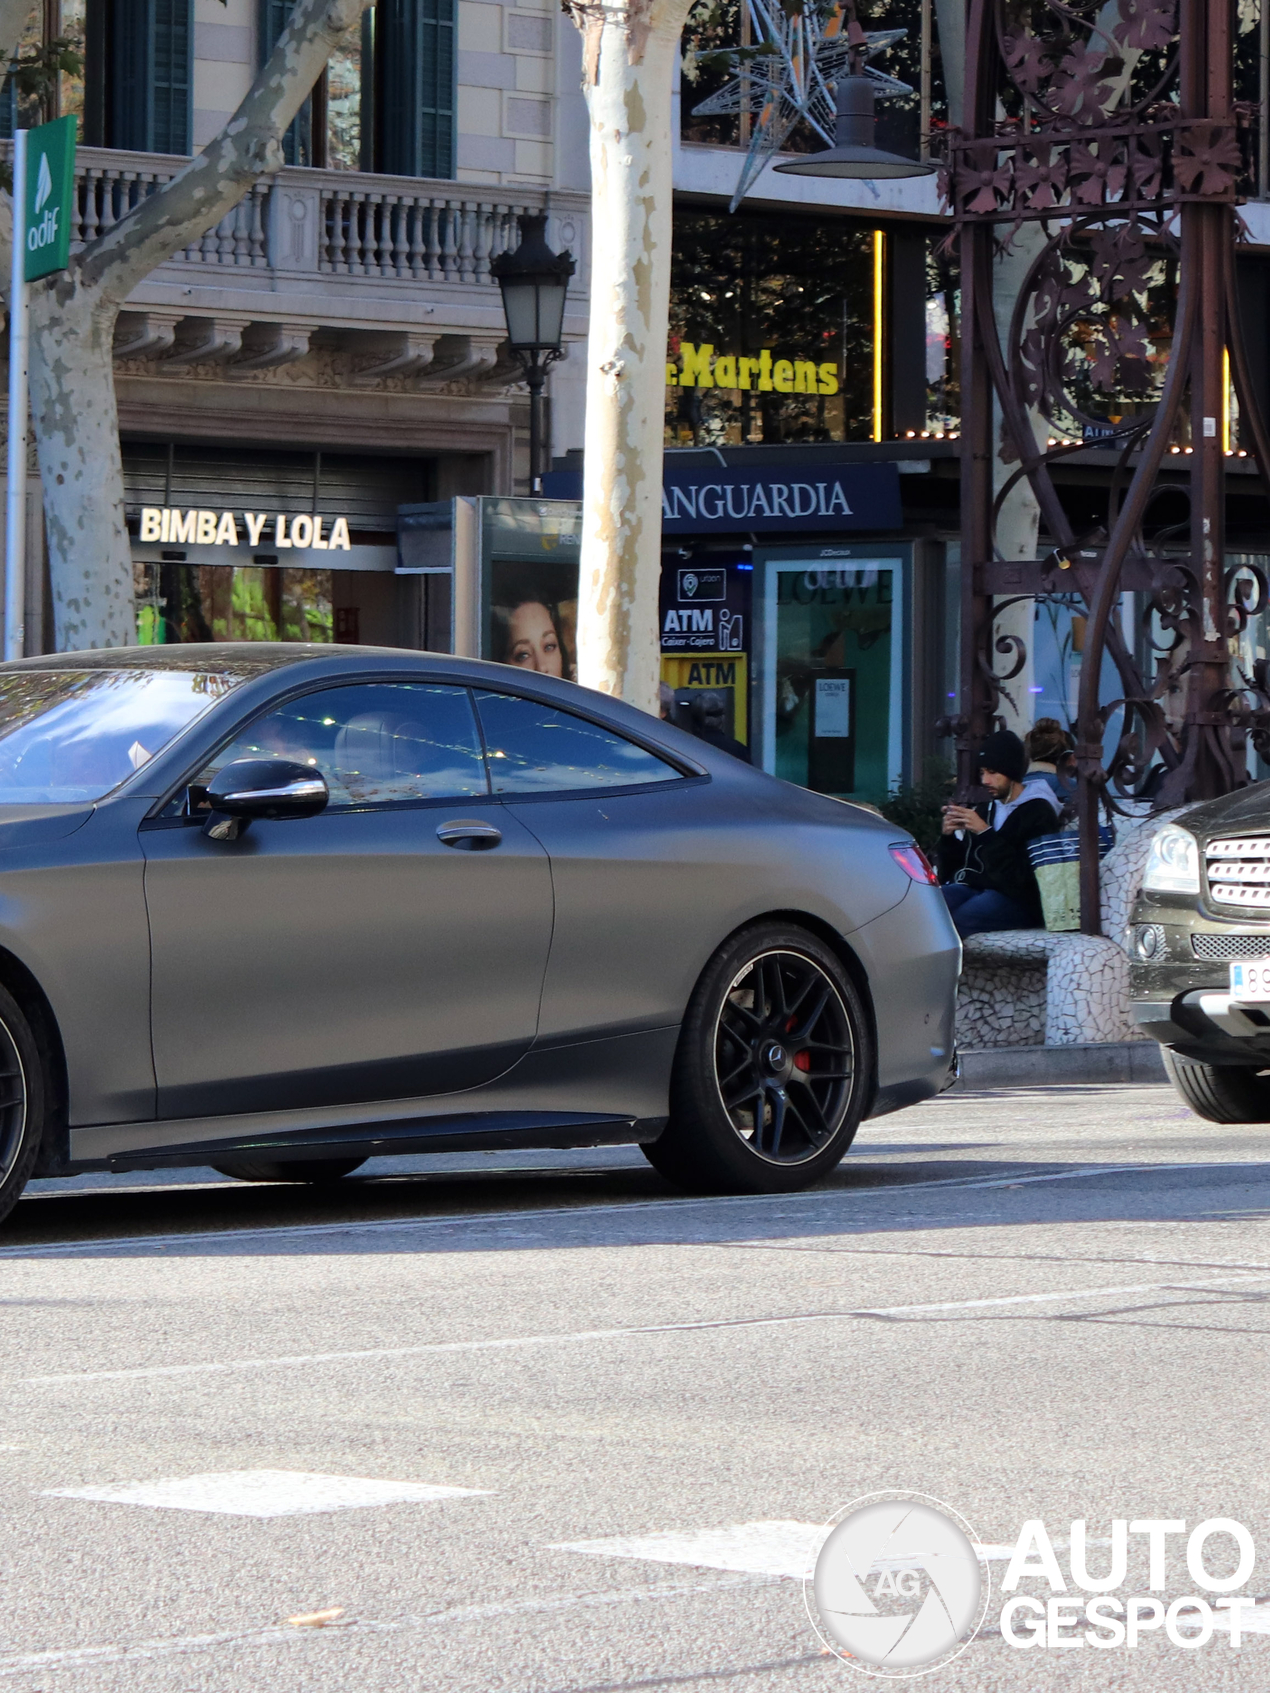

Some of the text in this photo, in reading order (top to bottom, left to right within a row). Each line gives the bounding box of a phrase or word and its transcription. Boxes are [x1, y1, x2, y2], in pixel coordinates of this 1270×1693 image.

[28, 206, 60, 251] adif
[680, 342, 839, 396] Martens
[662, 481, 854, 519] ANGUARDIA
[140, 508, 351, 550] BIMBA Y LOLA
[664, 609, 713, 632] ATM
[688, 662, 736, 685] ATM
